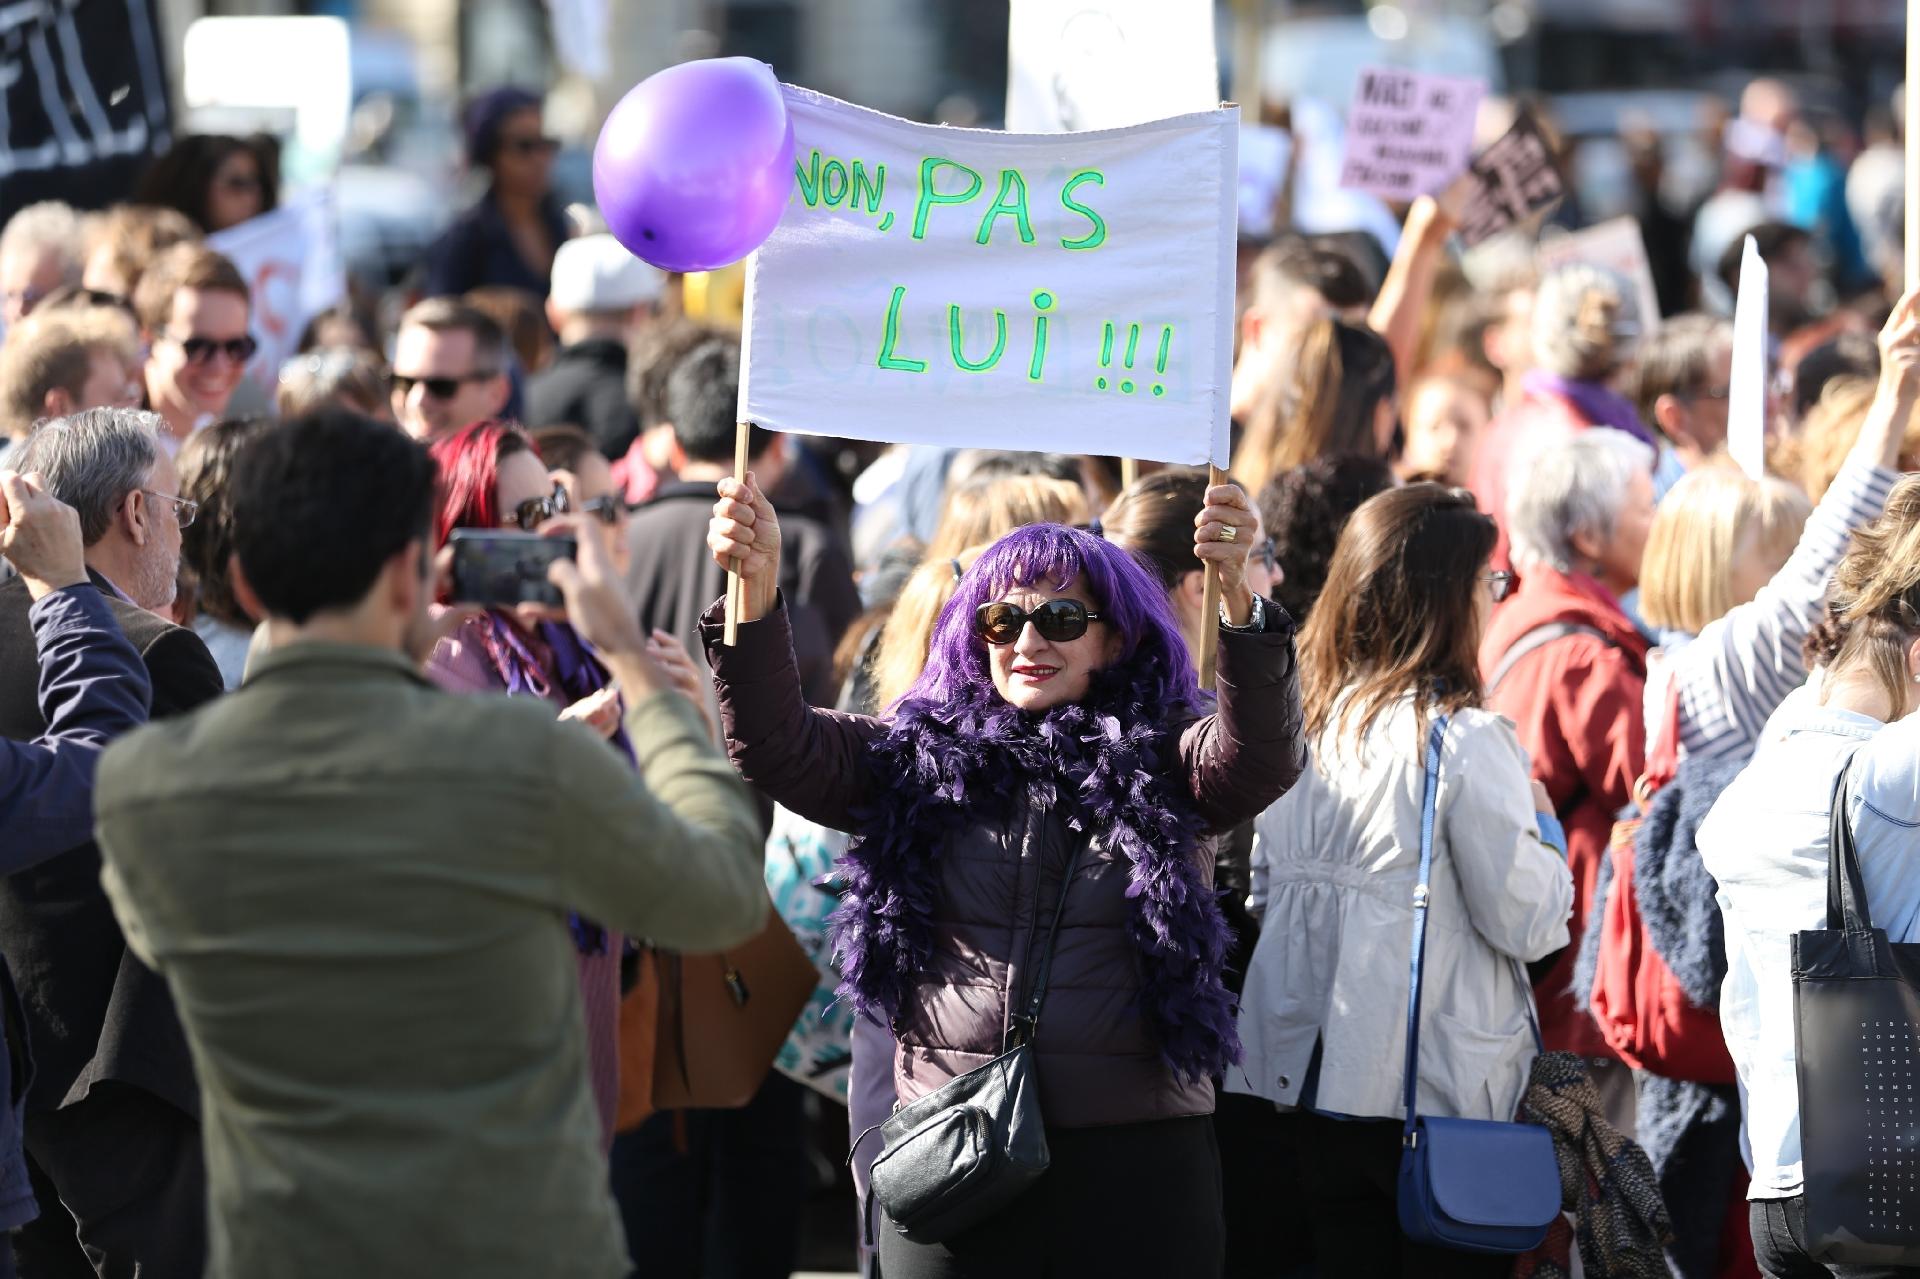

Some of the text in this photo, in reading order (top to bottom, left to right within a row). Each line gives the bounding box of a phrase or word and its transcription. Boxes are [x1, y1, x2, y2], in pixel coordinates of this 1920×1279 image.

[794, 150, 1107, 250] NON, PAS
[1096, 322, 1174, 398] !!!
